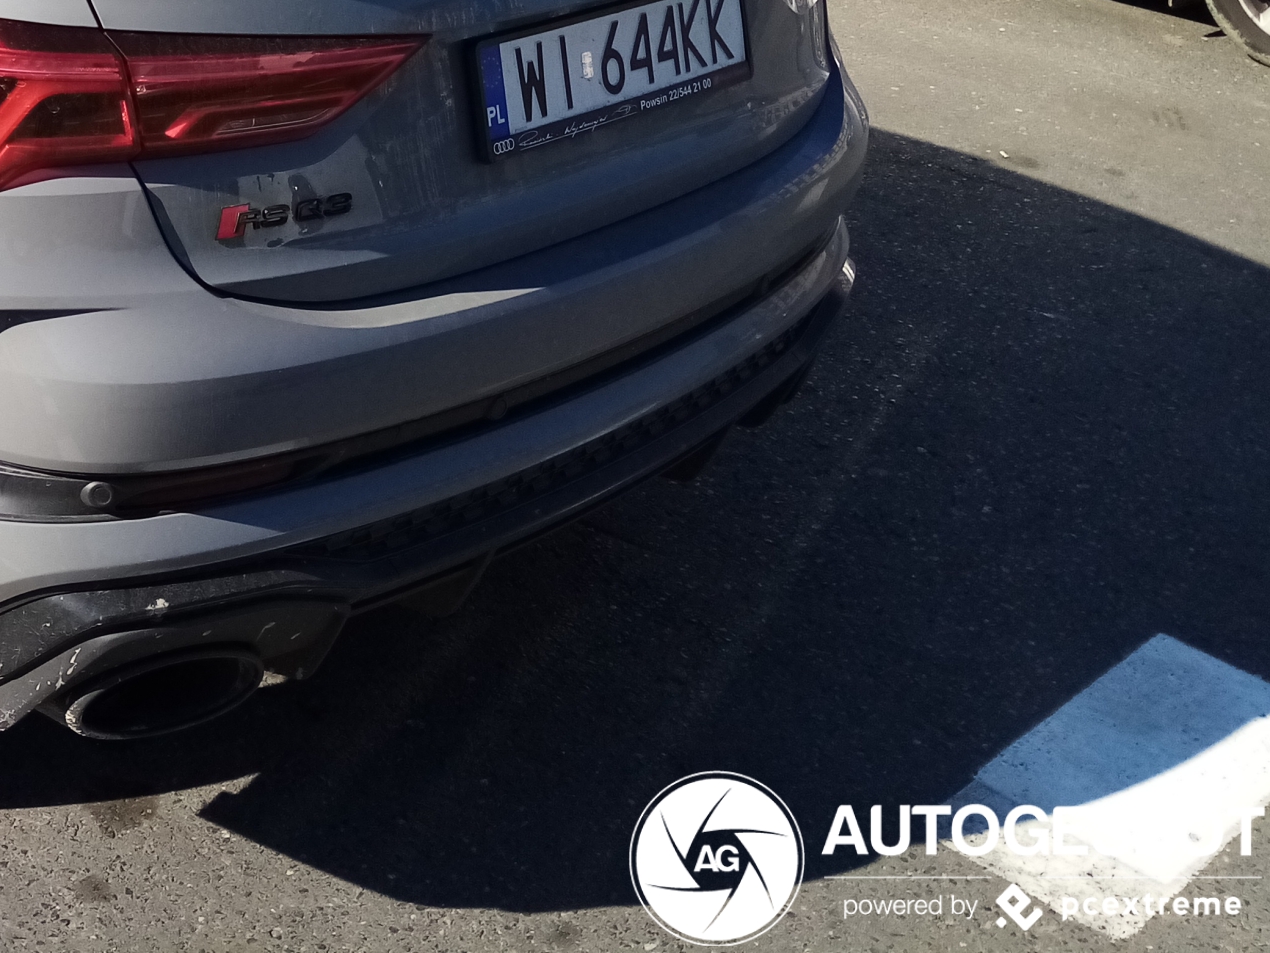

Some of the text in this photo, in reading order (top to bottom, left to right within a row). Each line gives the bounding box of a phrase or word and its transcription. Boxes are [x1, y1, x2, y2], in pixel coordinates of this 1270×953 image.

[515, 34, 574, 123] WI
[640, 94, 668, 110] Powsin
[669, 85, 692, 101] 22/544
[692, 81, 702, 93] 21
[702, 78, 712, 89] 00
[486, 104, 506, 127] PL
